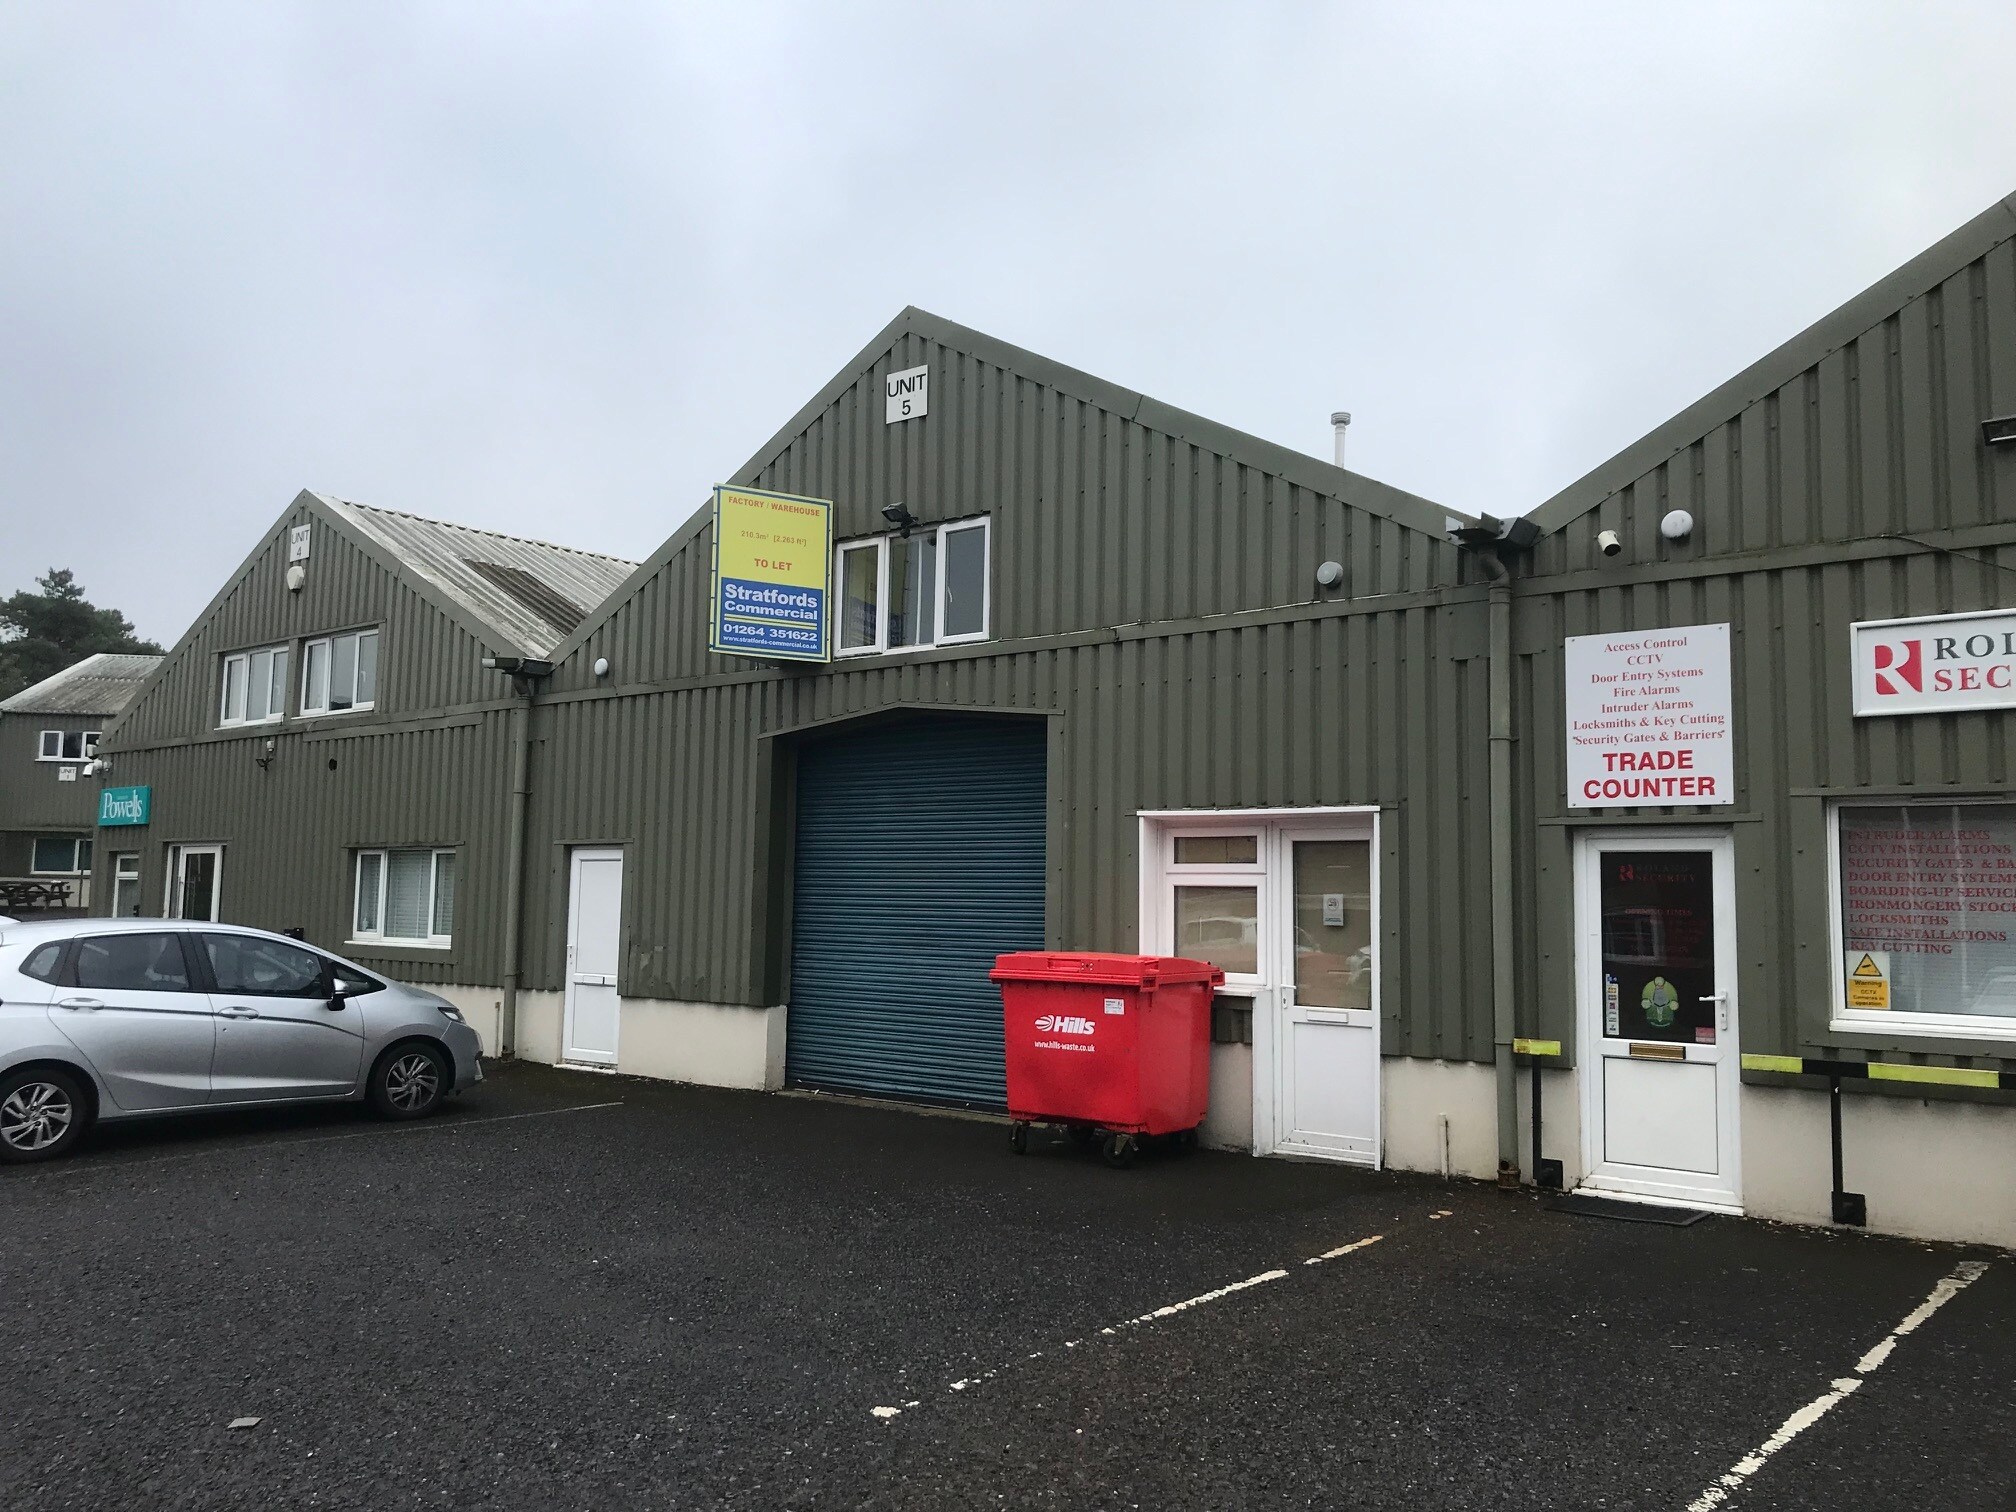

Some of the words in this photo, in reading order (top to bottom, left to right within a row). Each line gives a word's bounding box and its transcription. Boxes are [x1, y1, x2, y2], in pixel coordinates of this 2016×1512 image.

[887, 372, 927, 397] UNIT
[901, 398, 911, 415] 5
[728, 496, 764, 509] FACTORY
[771, 502, 820, 517] WAREHOUSE
[291, 529, 309, 544] UNIT
[296, 546, 302, 556] 4
[754, 558, 769, 569] TO
[772, 560, 792, 571] LET
[724, 583, 818, 608] Stratfords
[724, 601, 818, 620] Commercial
[723, 624, 765, 636] 01264
[769, 628, 818, 642] 351622
[723, 635, 818, 650] www.stratfords-commercial.co.uk
[1604, 642, 1640, 653] Access
[1643, 637, 1687, 650] Control
[1627, 654, 1664, 665] CCTV
[1591, 673, 1618, 684] Door
[1622, 671, 1653, 683] Entry
[1657, 668, 1704, 682] Systems
[1934, 664, 2012, 692] SEC
[1613, 687, 1636, 697] Fire
[1639, 684, 1680, 696] Alarms
[1601, 701, 1649, 713] Intruder
[1652, 699, 1694, 711] Alarms
[1573, 718, 1636, 730] Locksmiths
[1639, 717, 1650, 727] &
[1654, 715, 1676, 728] Key
[1680, 713, 1725, 726] Cutting
[1623, 732, 1656, 744] Gates
[1659, 731, 1670, 741] &
[1602, 749, 1694, 772] TRADE
[1583, 776, 1715, 799] COUNTER
[101, 789, 143, 823] Powells
[1928, 830, 1990, 840] ALARMS
[1848, 858, 1921, 868] SECURITY
[1925, 859, 1974, 868] GATES
[1981, 859, 1992, 868] &
[1848, 871, 1892, 882] DOOR
[1896, 872, 1947, 882] ENTRY
[1848, 886, 1953, 898] BOARDING-UP
[1957, 887, 2016, 899] SERVIC
[1849, 900, 1963, 911] IRONMONGERY
[1849, 913, 1949, 925] LOCKSMITHS
[1850, 927, 1884, 938] SAFE
[1887, 928, 2007, 941] INSTALLATIONS
[1850, 941, 1880, 951] KEY
[1882, 942, 1953, 955] CUTTING
[1053, 1015, 1096, 1035] Hills
[1034, 1040, 1095, 1052] www.hills-waste.co.uk
